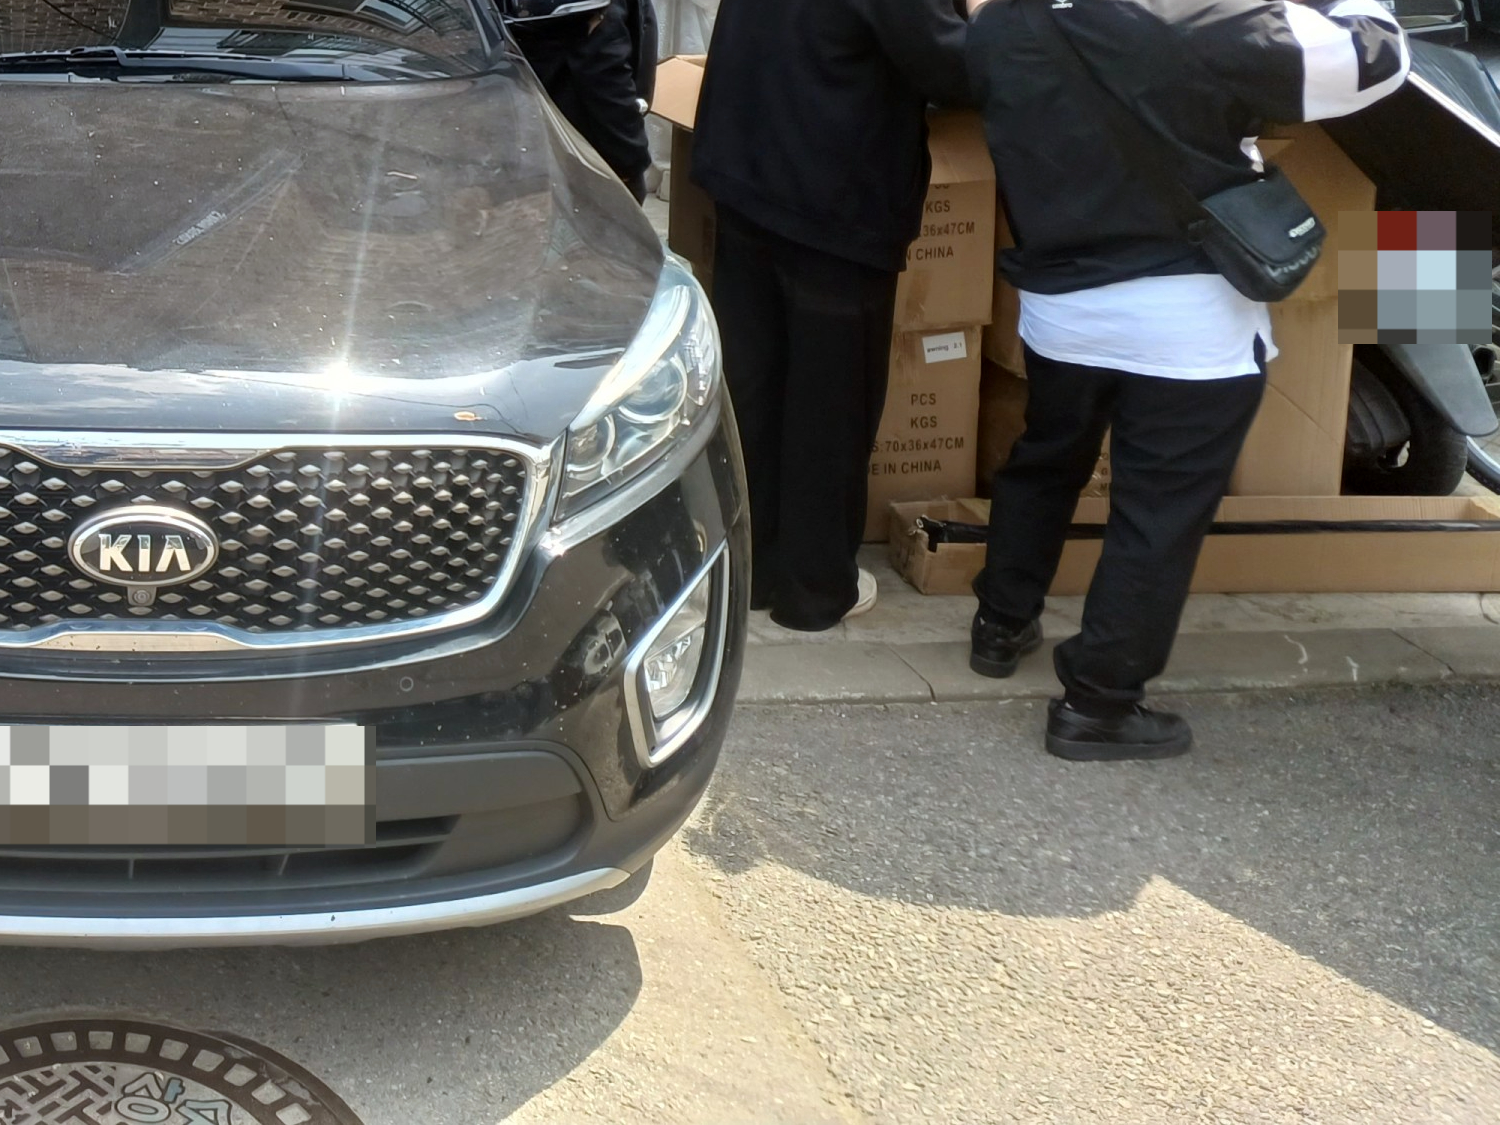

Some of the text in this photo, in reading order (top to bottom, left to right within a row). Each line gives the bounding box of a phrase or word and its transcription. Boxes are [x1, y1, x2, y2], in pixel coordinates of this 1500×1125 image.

[925, 199, 951, 214] KGS
[915, 245, 955, 261] CHINA
[910, 393, 937, 406] PCS
[910, 416, 938, 429] KGS
[883, 463, 897, 475] IN
[900, 459, 942, 475] CHINA
[98, 533, 192, 573] KIA
